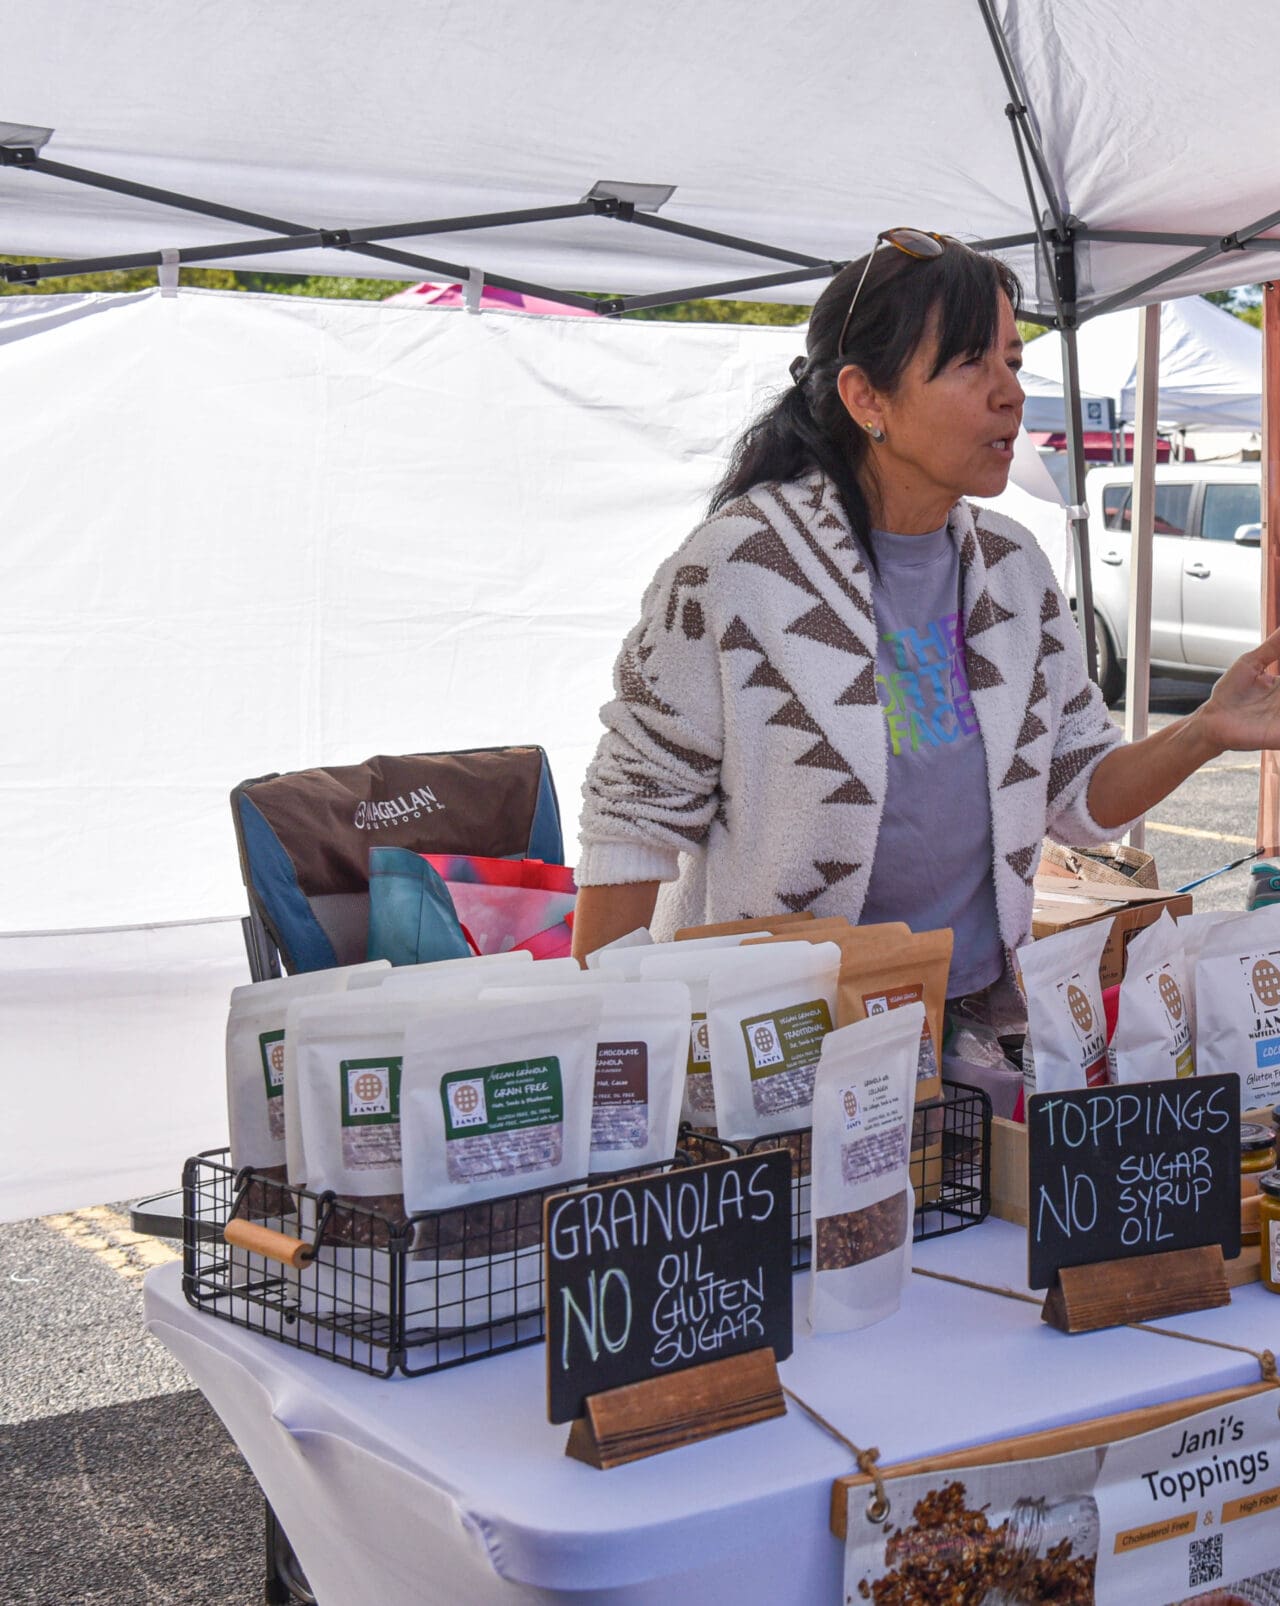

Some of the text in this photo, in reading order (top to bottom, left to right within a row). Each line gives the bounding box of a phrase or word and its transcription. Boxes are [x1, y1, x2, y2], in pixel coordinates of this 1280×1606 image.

[887, 695, 980, 756] FACE
[365, 785, 437, 821] MAGELLAN
[599, 1048, 640, 1057] CHOCOLATE
[1246, 1072, 1273, 1085] Gluten
[352, 1105, 386, 1114] JANI'S
[494, 1086, 522, 1098] GRAIN
[524, 1082, 549, 1093] FREE
[1038, 1086, 1231, 1148] TOPPINGS
[551, 1163, 775, 1261] GRANOLAS
[1036, 1147, 1213, 1243] NO SUGAR
[1117, 1178, 1212, 1219] SYRUP
[1120, 1212, 1174, 1245] OIL
[560, 1243, 716, 1371] NO OIL
[652, 1265, 766, 1335] GLUTEN
[650, 1303, 765, 1368] SUGAR
[1171, 1415, 1245, 1459] Jani's
[1141, 1449, 1270, 1503] Toppings
[1122, 1493, 1279, 1547] Cholesterol Free & High Fiber
